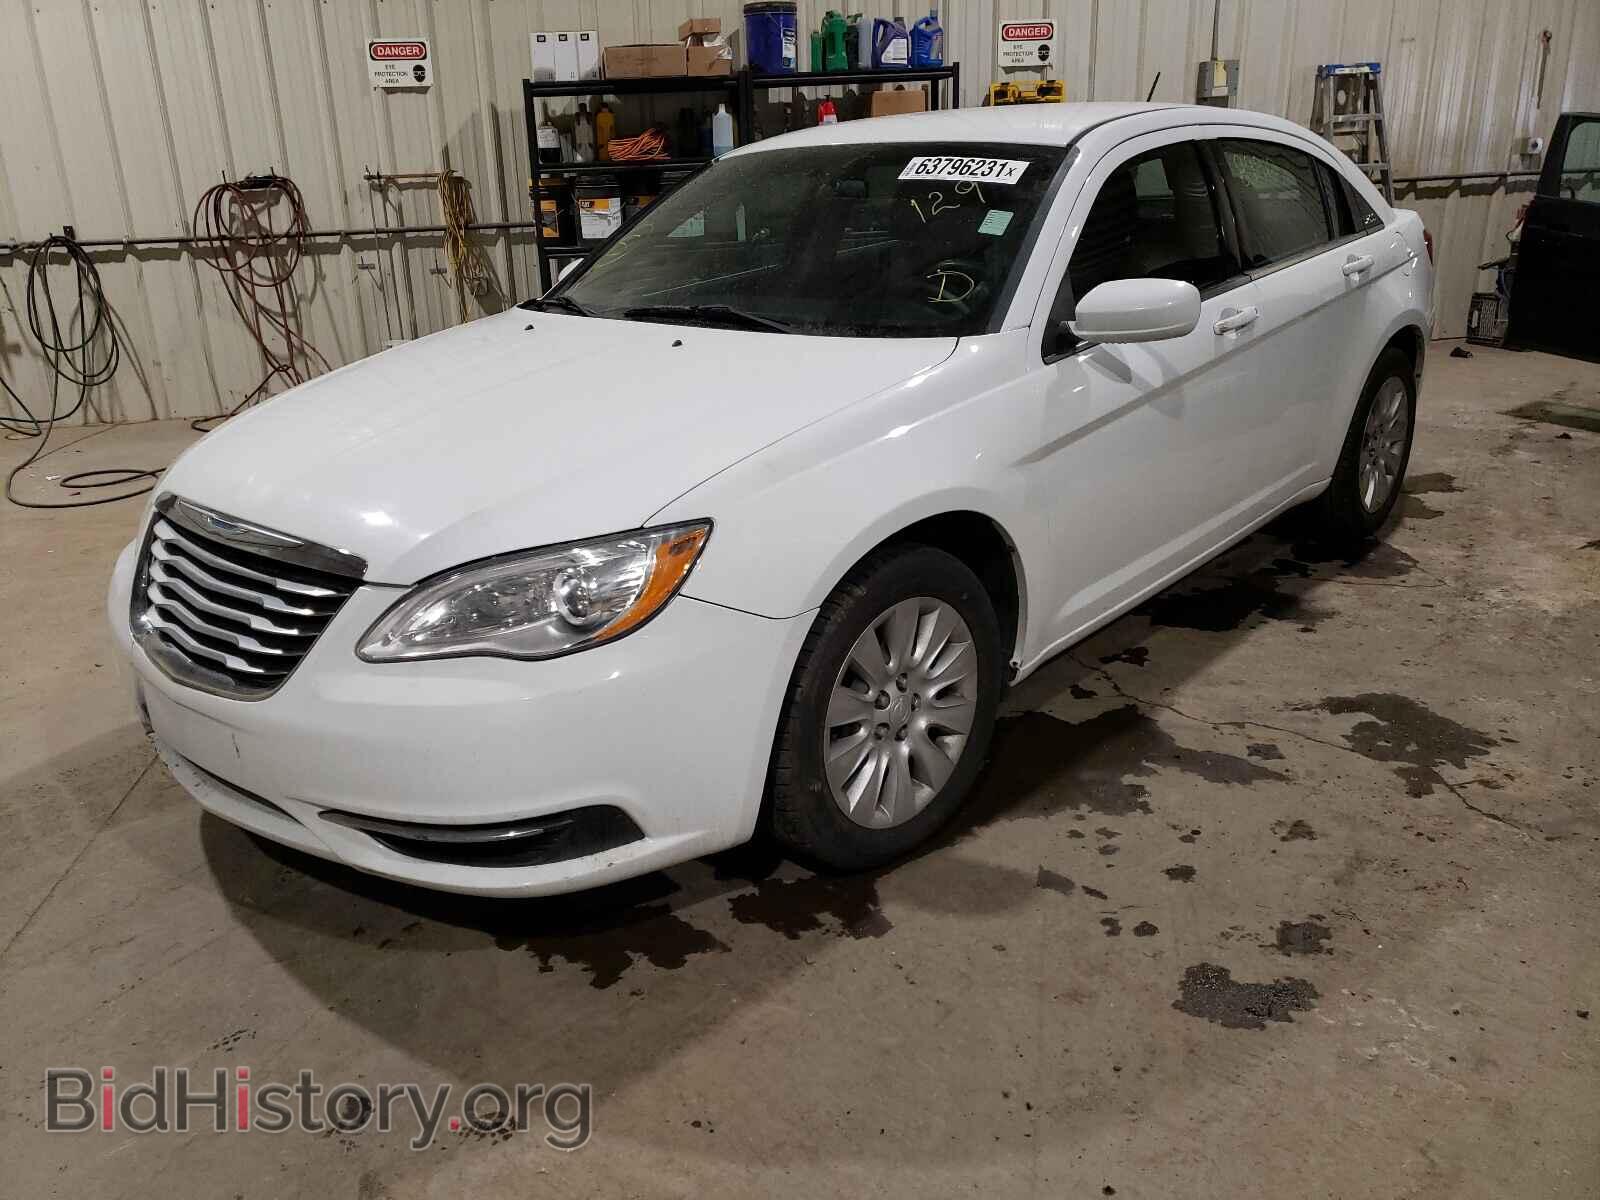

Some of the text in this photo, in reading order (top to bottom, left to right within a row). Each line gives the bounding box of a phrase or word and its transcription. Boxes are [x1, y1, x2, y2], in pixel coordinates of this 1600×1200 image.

[1008, 27, 1048, 37] DANGER
[377, 46, 420, 56] DANGER
[926, 268, 975, 303] D
